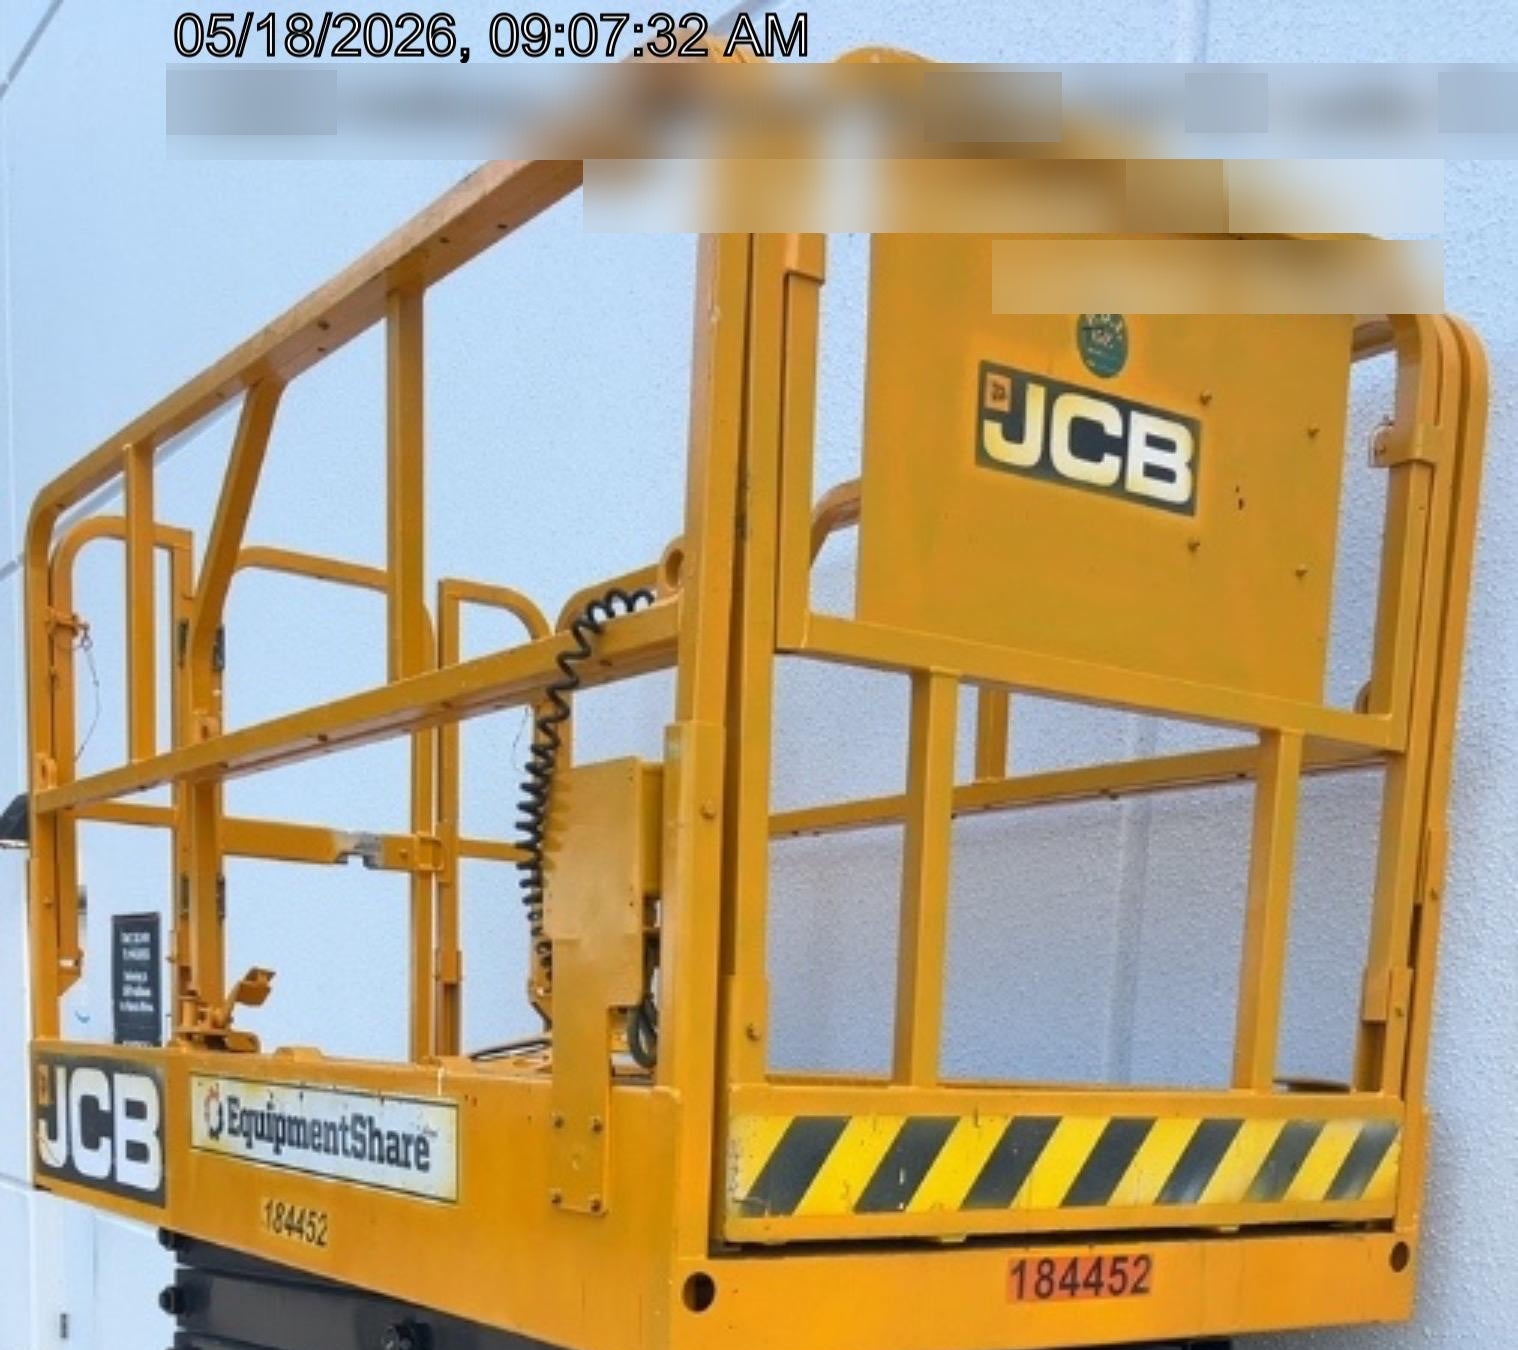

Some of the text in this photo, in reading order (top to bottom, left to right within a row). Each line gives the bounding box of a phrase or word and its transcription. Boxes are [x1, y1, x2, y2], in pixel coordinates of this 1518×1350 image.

[983, 383, 1194, 504] JCB
[38, 1066, 163, 1192] JCB
[227, 1096, 430, 1173] EquipmentShare
[264, 1200, 328, 1247] 184452
[1010, 1253, 1153, 1300] 184452
